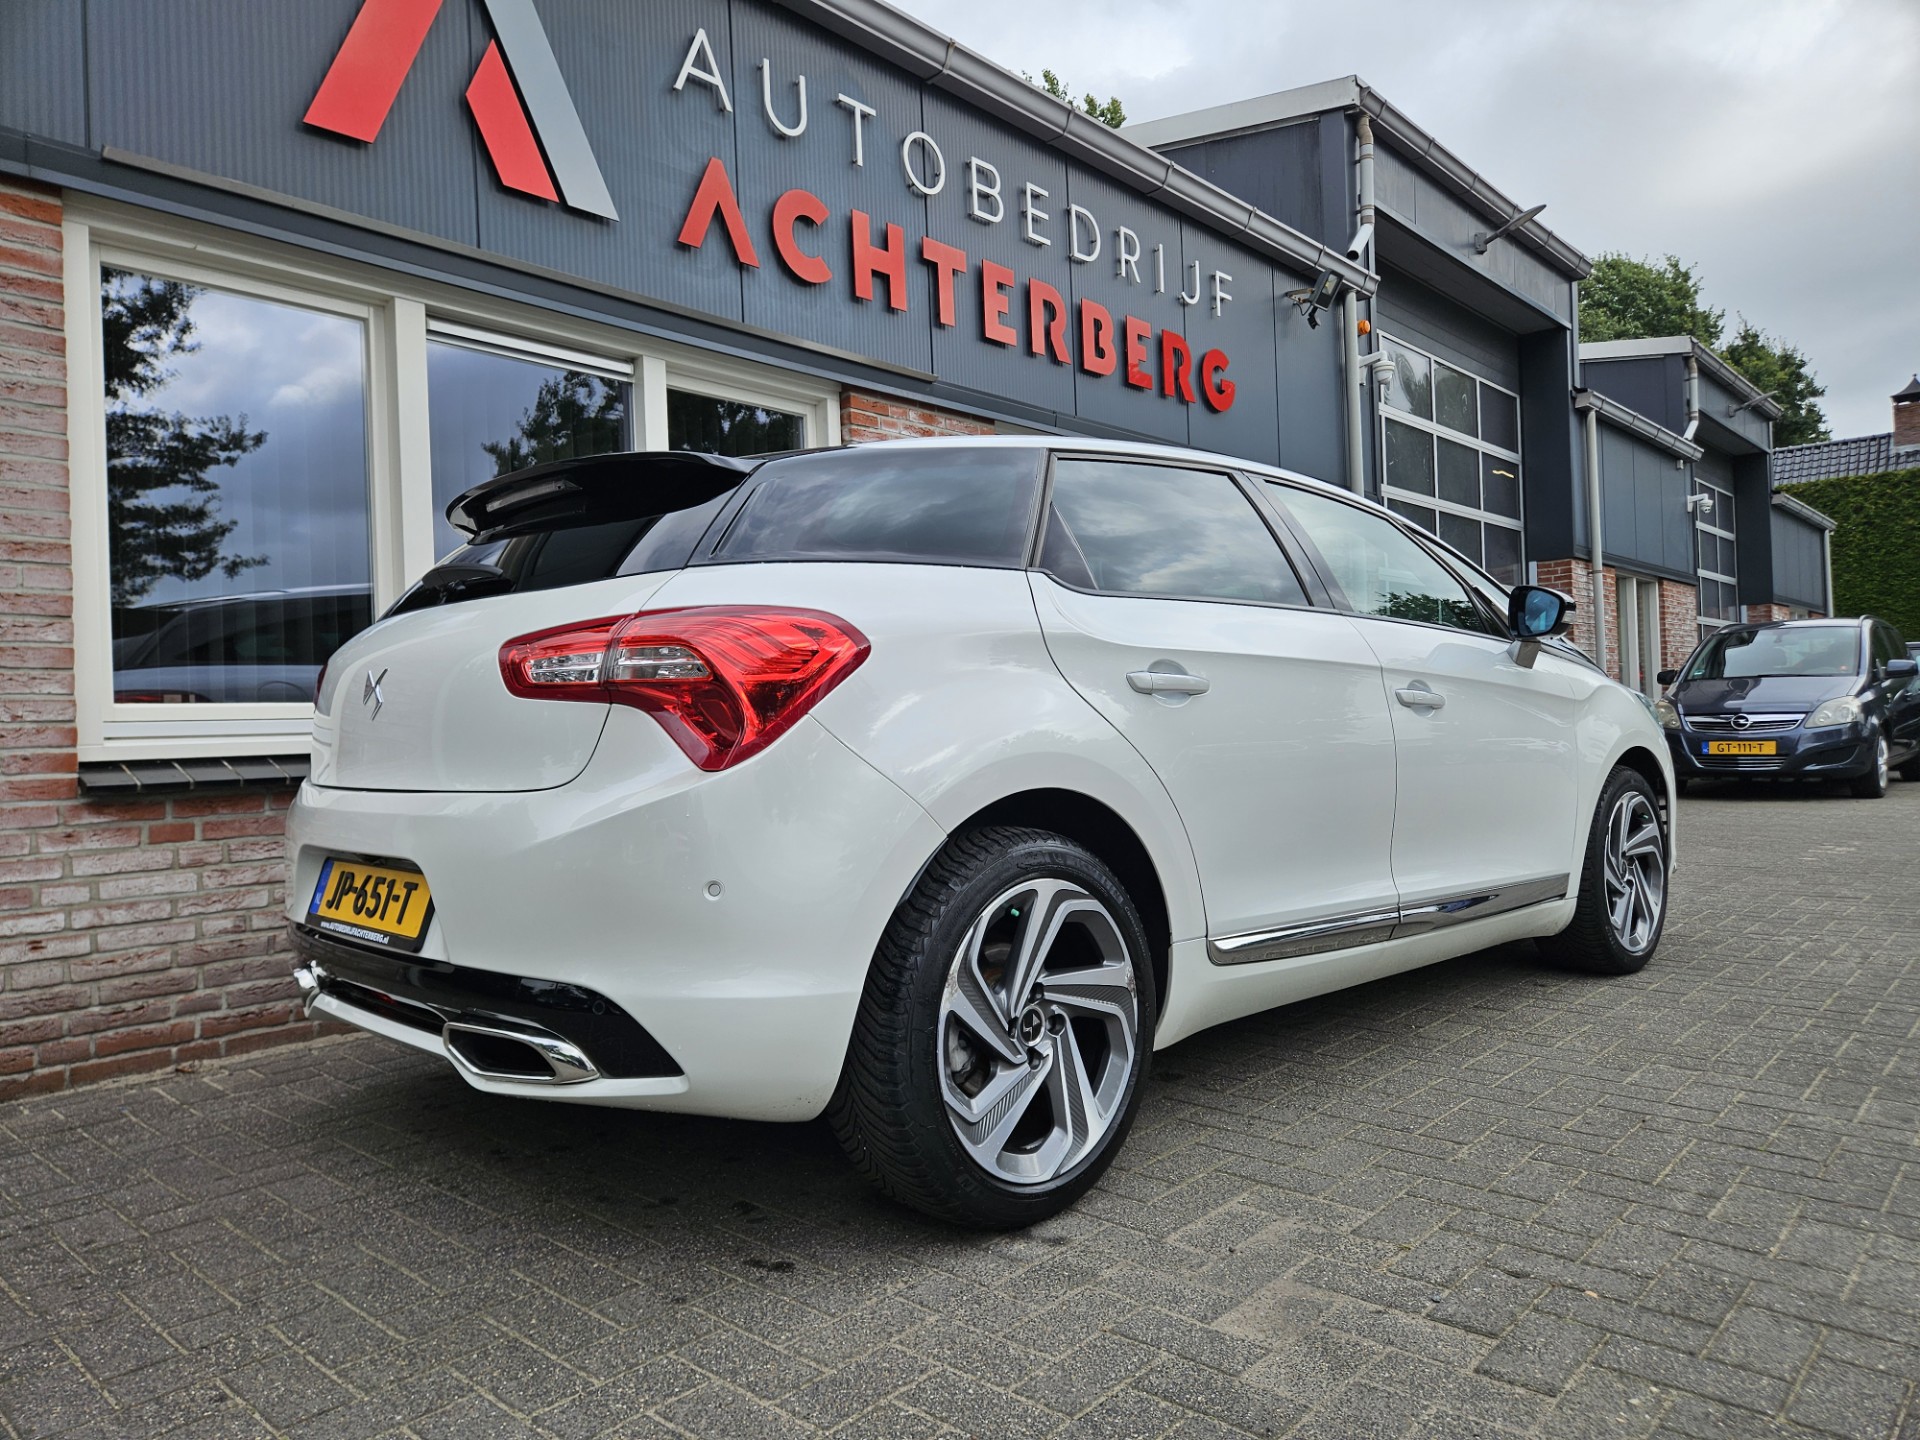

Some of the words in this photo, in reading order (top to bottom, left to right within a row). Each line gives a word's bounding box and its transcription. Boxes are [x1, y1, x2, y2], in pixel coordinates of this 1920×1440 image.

[673, 28, 1233, 317] AUTOBEDRIJF
[678, 156, 1236, 413] ACHTERBERG
[1716, 743, 1765, 753] GT-111-T
[325, 870, 419, 925] JP-651-T
